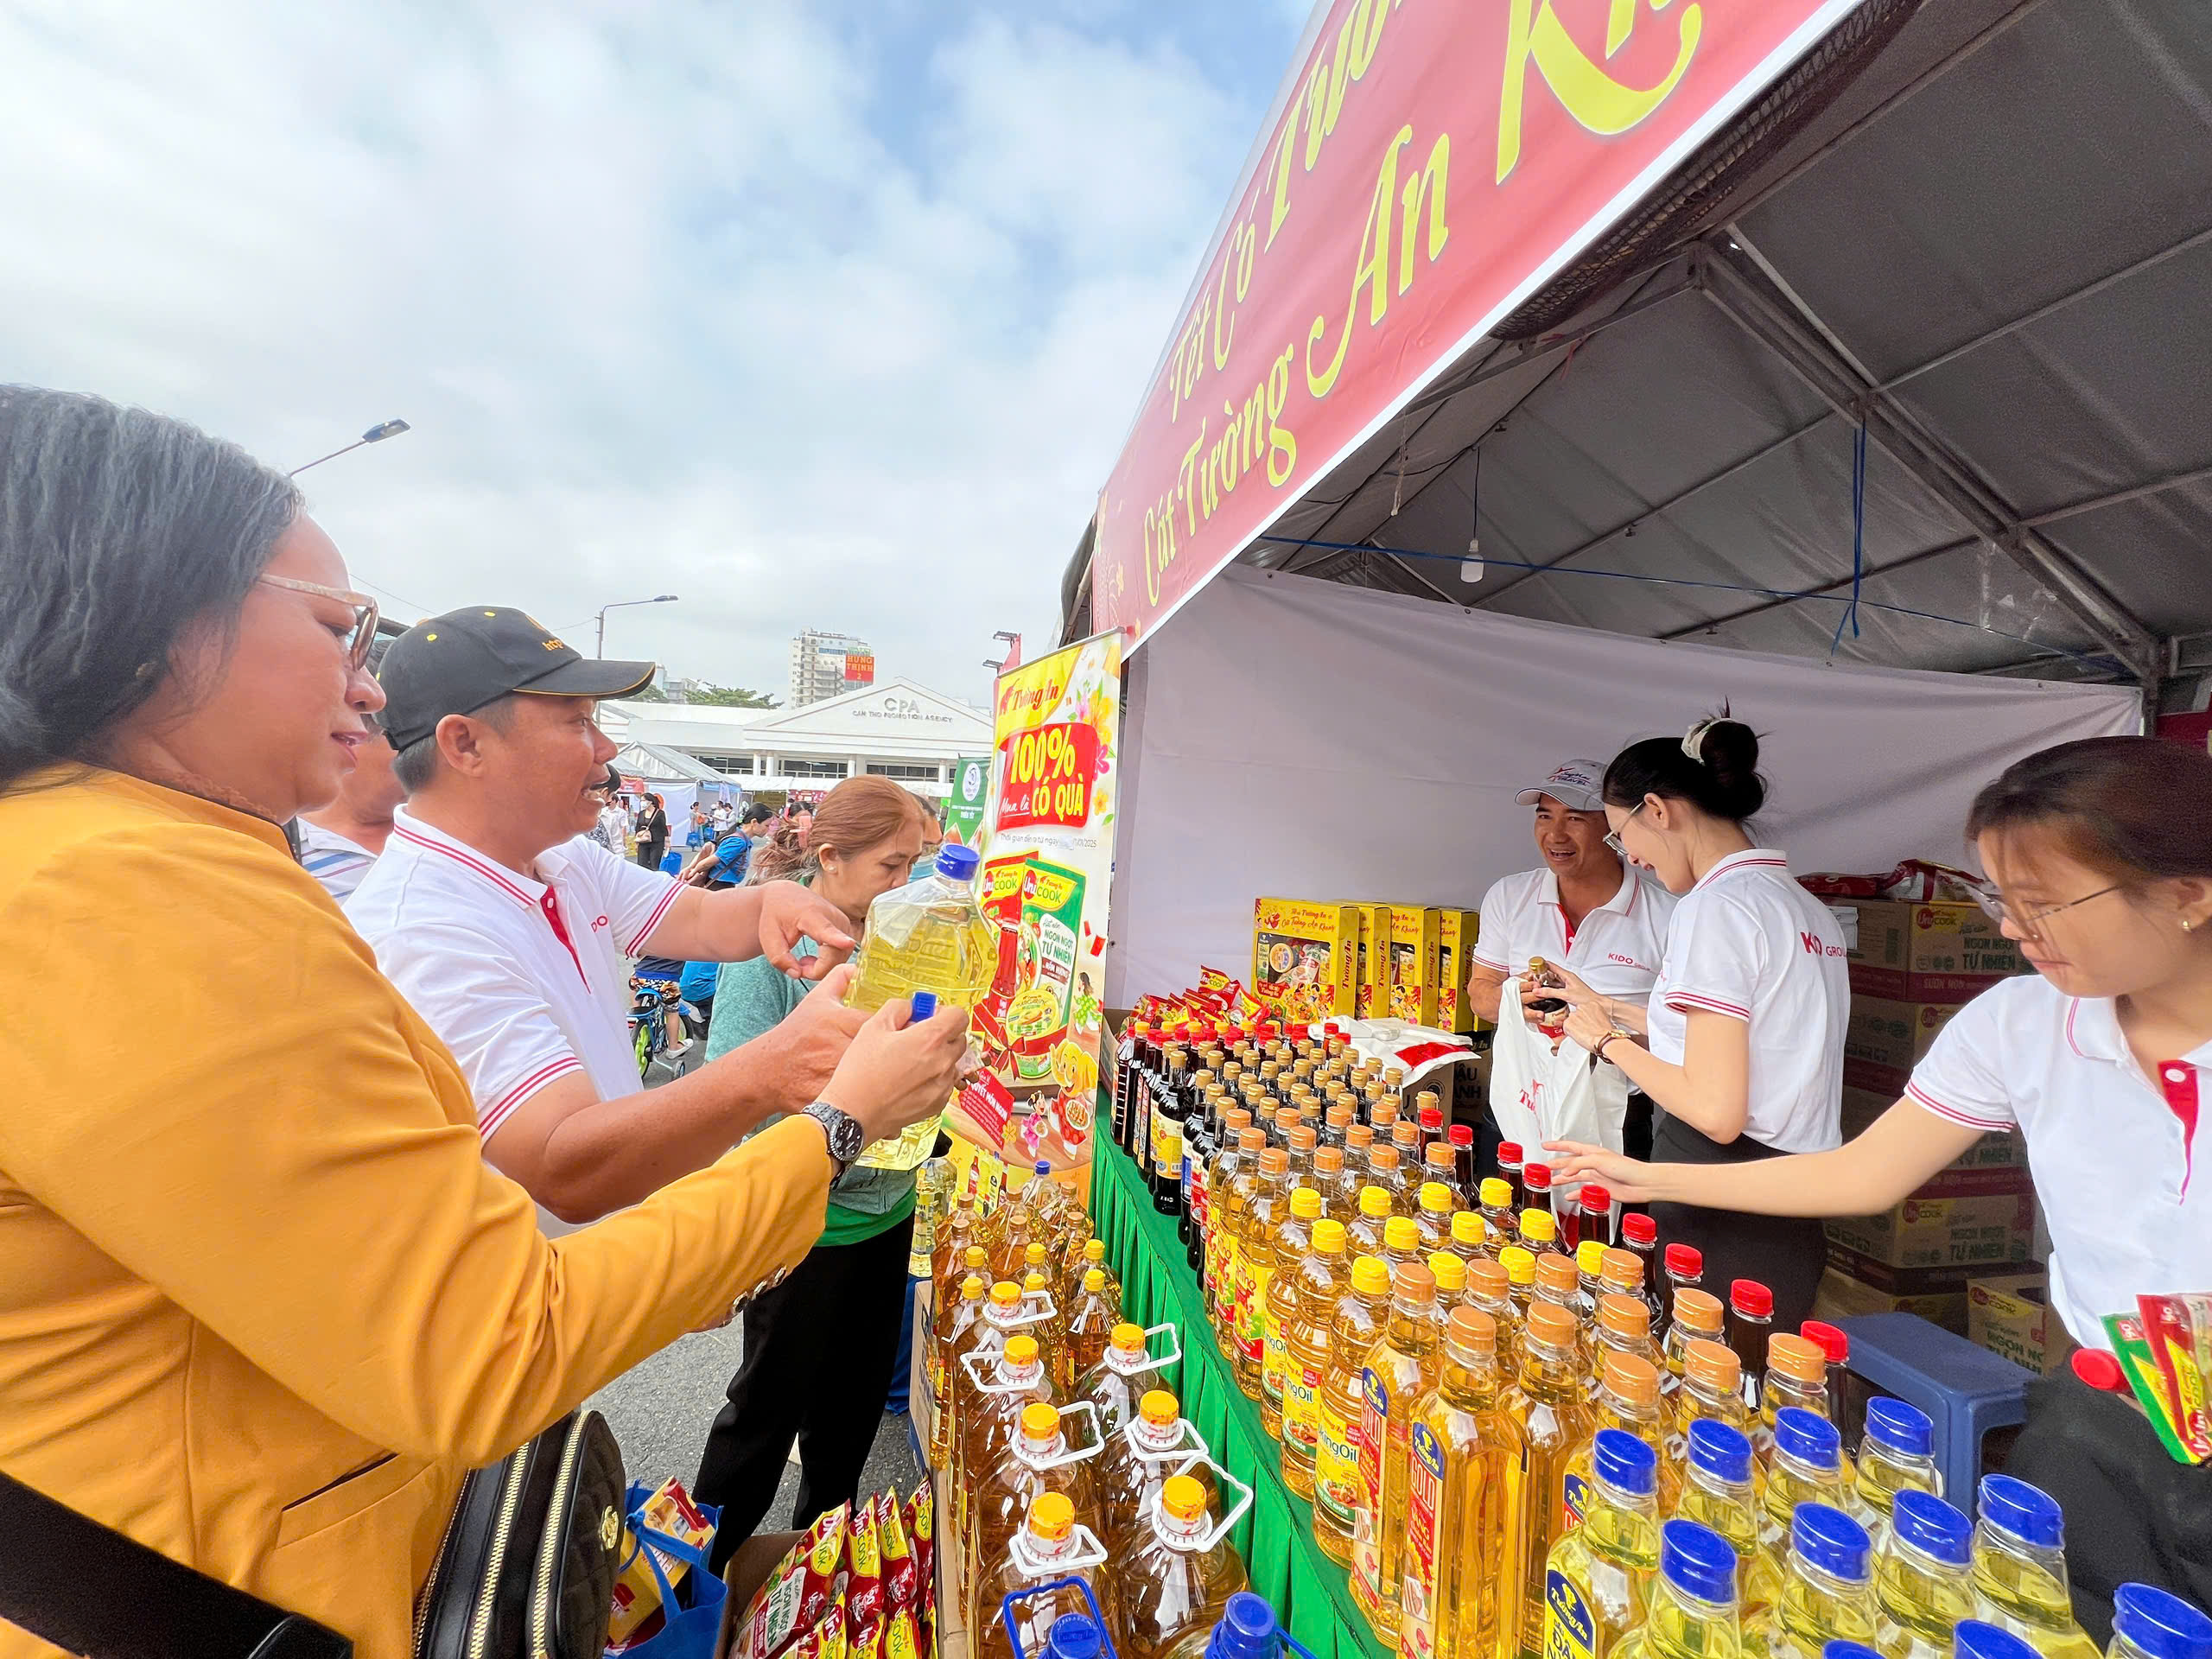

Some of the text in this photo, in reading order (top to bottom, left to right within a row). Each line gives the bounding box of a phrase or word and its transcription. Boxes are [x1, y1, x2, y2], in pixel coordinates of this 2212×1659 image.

[1143, 486, 1177, 607] Cát
[1177, 341, 1297, 537] Tường
[1306, 124, 1450, 398] An
[885, 697, 920, 714] CPA
[1009, 724, 1076, 784] 100%
[999, 773, 1084, 823] Mua là CÓ QUÀ
[1608, 952, 1633, 964] KIDO
[1361, 1398, 1381, 1445] GOLD
[1410, 1455, 1436, 1512] GOLD
